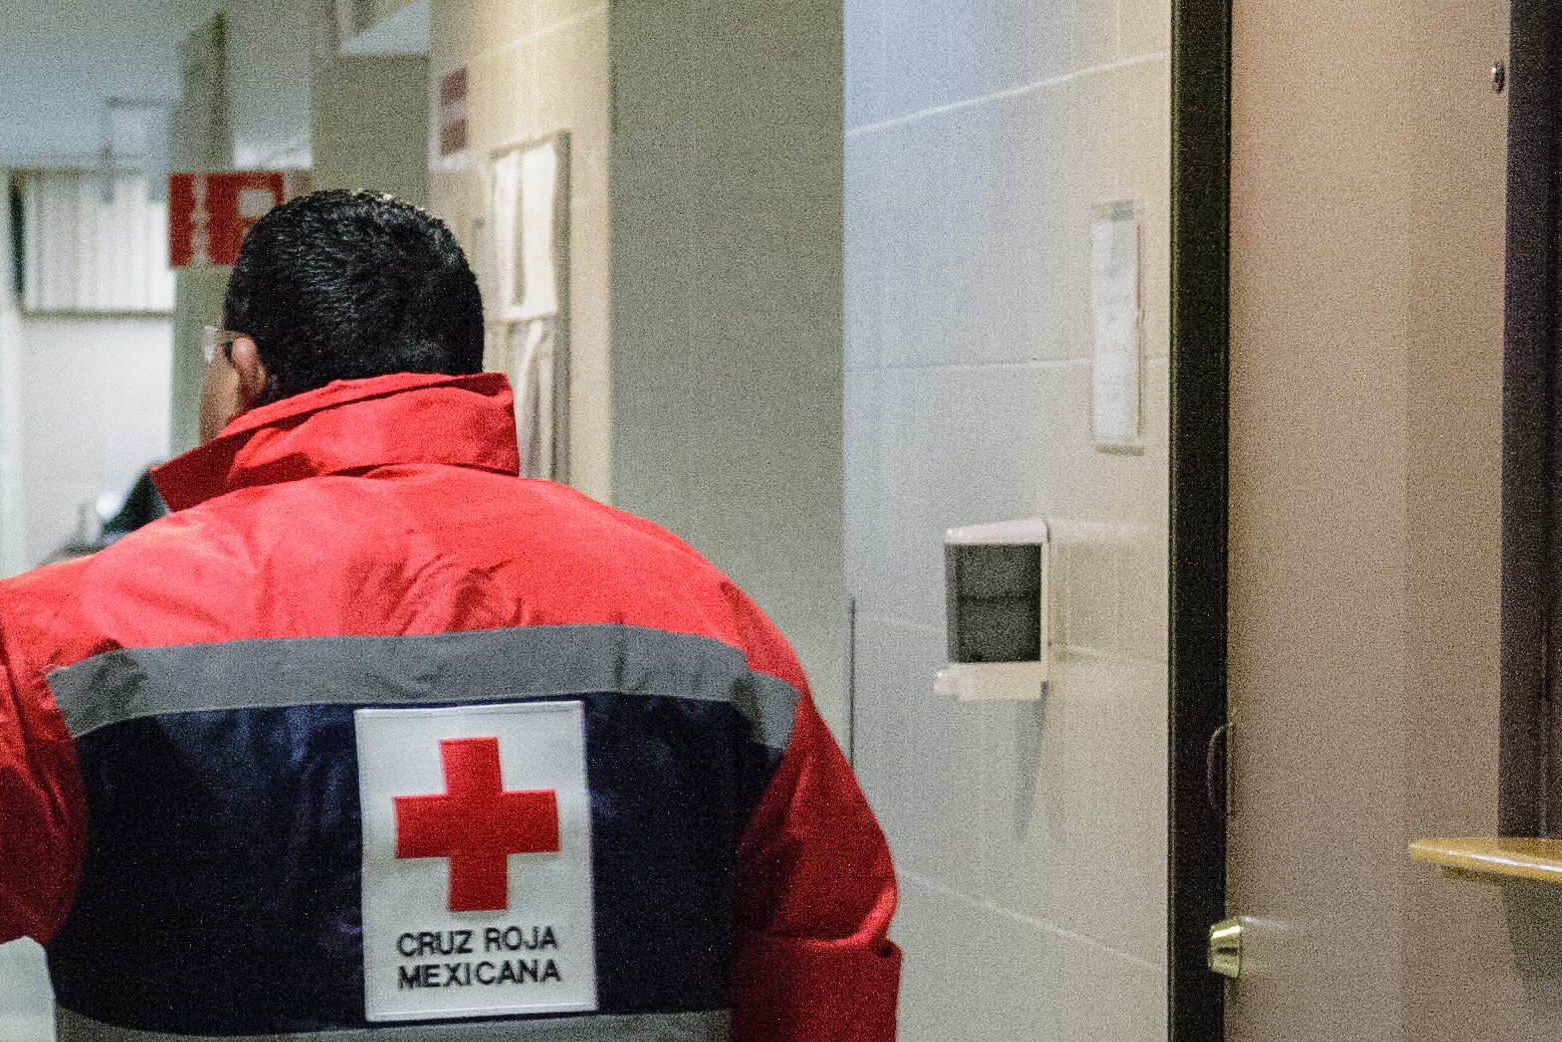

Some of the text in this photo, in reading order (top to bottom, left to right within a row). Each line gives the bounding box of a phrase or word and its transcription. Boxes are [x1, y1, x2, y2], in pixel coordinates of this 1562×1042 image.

[396, 926, 558, 956] CRUZ ROJA
[398, 959, 562, 988] MEXICANA
